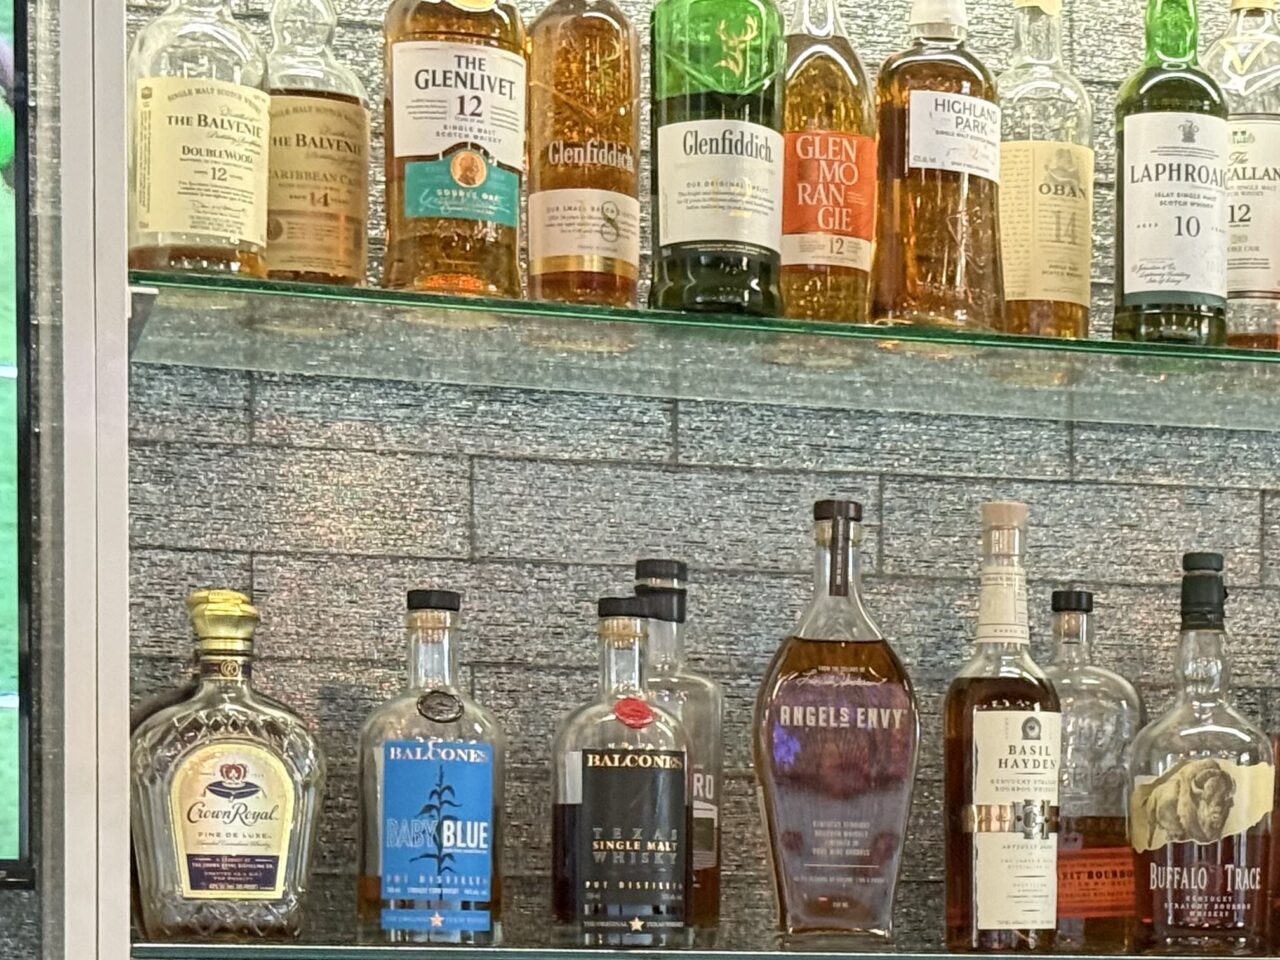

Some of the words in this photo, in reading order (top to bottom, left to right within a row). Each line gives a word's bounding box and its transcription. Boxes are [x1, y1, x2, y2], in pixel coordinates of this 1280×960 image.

[454, 54, 486, 72] THE
[414, 69, 516, 100] GLENLIVET
[457, 95, 483, 118] 12
[167, 115, 193, 126] THE
[197, 114, 263, 139] BALVENIE
[955, 116, 988, 136] PARK
[273, 136, 292, 147] HE
[683, 129, 773, 163] Glenfiddich
[796, 135, 858, 162] GLEN
[182, 145, 253, 164] DOUBLEWOOD
[548, 138, 635, 168] Glenfiddich
[210, 167, 228, 182] 12
[270, 169, 337, 183] ARIBBEAN
[818, 160, 858, 186] MO
[797, 182, 846, 206] RAN
[1038, 182, 1088, 200] OBAN
[817, 206, 852, 232] GIE
[1228, 203, 1252, 224] 12
[1174, 216, 1201, 238] 10
[829, 237, 844, 255] 12
[780, 706, 850, 728] ANGELS
[856, 707, 903, 730] ENVY
[390, 746, 488, 763] BALCONES
[1008, 744, 1052, 757] BASIL
[586, 754, 684, 770] BALCONES
[186, 801, 233, 824] Crown
[232, 802, 279, 827] Royal
[386, 818, 440, 848] BABY
[442, 820, 489, 848] BLUE
[592, 827, 678, 840] TEXAS
[592, 841, 641, 850] SINGLE
[646, 841, 678, 852] MALT
[592, 851, 678, 864] WHISKY
[1087, 870, 1134, 880] BOURBO
[1150, 862, 1208, 890] BUFFALO
[1224, 864, 1261, 892] TRACE
